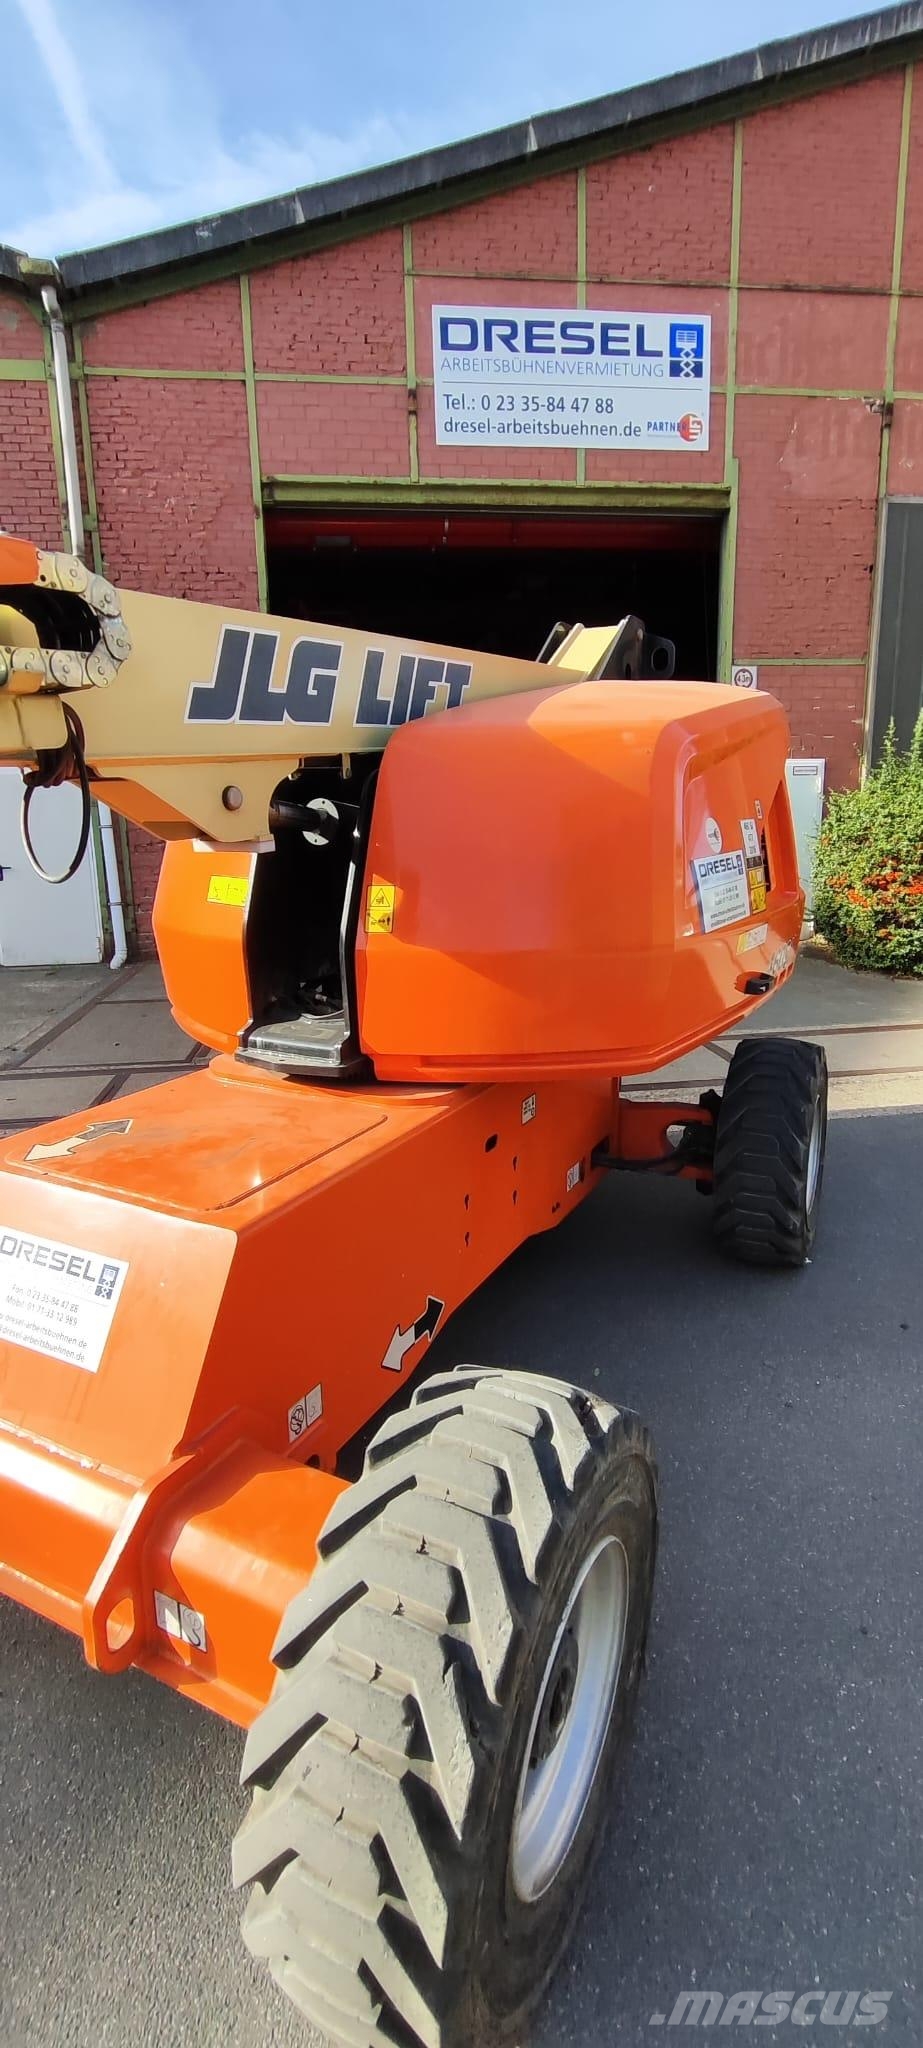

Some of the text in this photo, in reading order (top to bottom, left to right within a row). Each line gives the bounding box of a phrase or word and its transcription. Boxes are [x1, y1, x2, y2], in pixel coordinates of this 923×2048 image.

[440, 317, 663, 358] DRESEL
[440, 357, 664, 378] ARBEITSBÜHNENVERMIETUNG
[443, 394, 614, 413] Tel.: 0 23 35-84 47 88
[444, 417, 641, 437] dresel-arbeitsbuehnen.de
[647, 421, 687, 432] PARTNER
[184, 624, 474, 728] JLG LIFT
[698, 857, 737, 878] DRESEL
[0, 1235, 96, 1282] DRESEL
